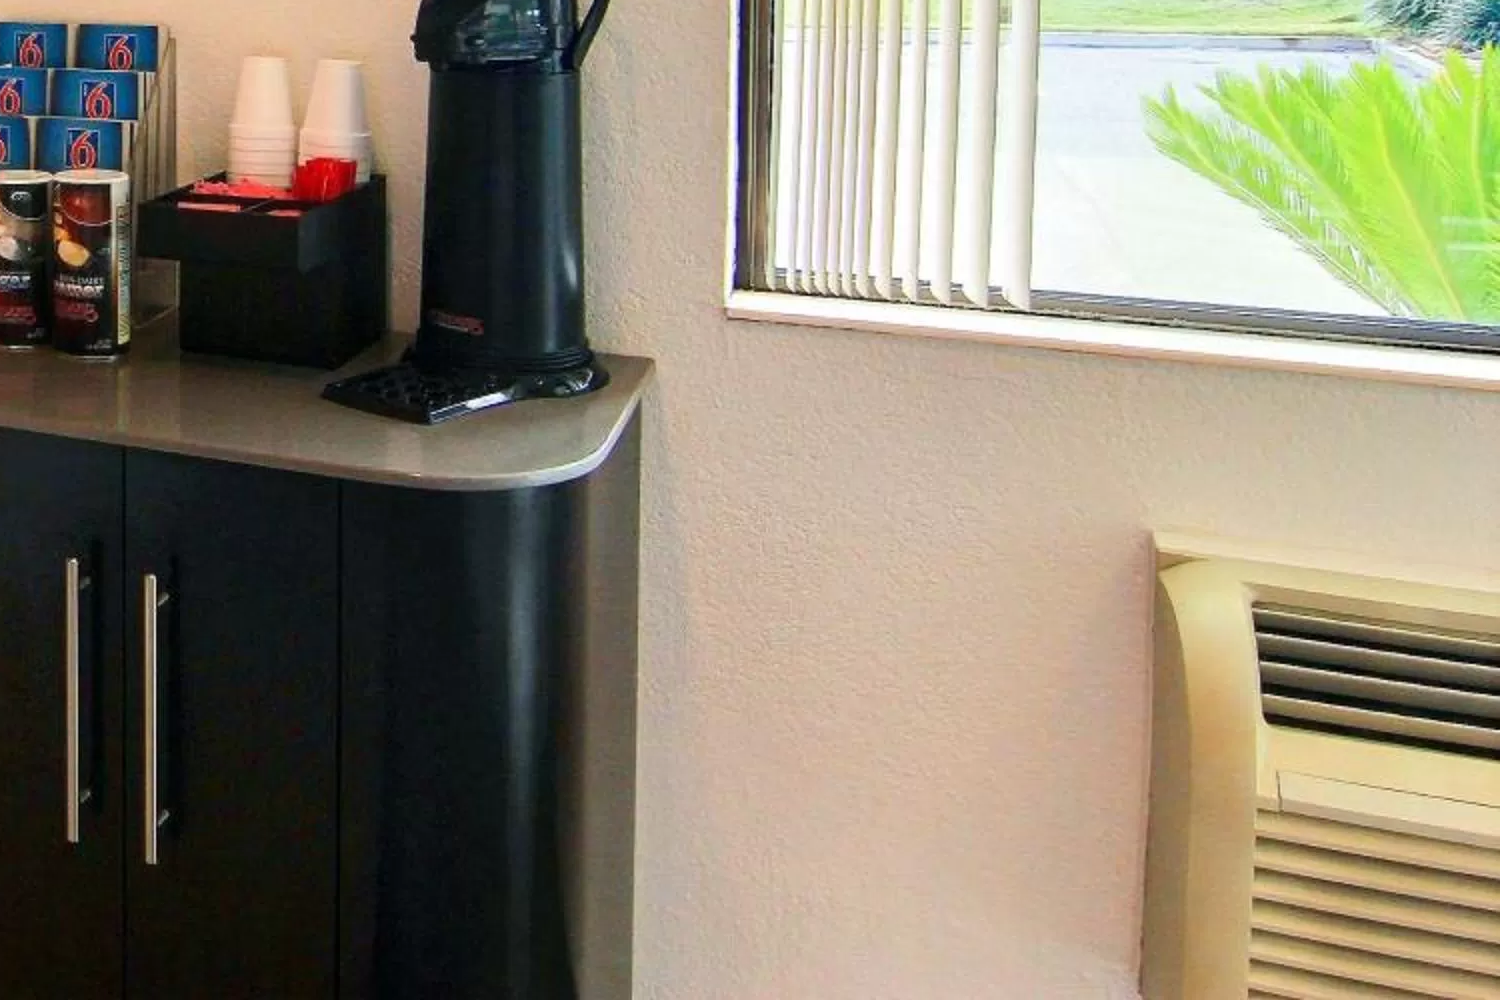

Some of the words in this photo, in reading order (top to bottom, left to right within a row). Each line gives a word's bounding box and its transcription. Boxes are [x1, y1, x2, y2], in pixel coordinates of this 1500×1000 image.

[19, 31, 42, 68] 6
[108, 34, 133, 70] 6
[85, 80, 112, 120] 6
[70, 130, 97, 169] 6
